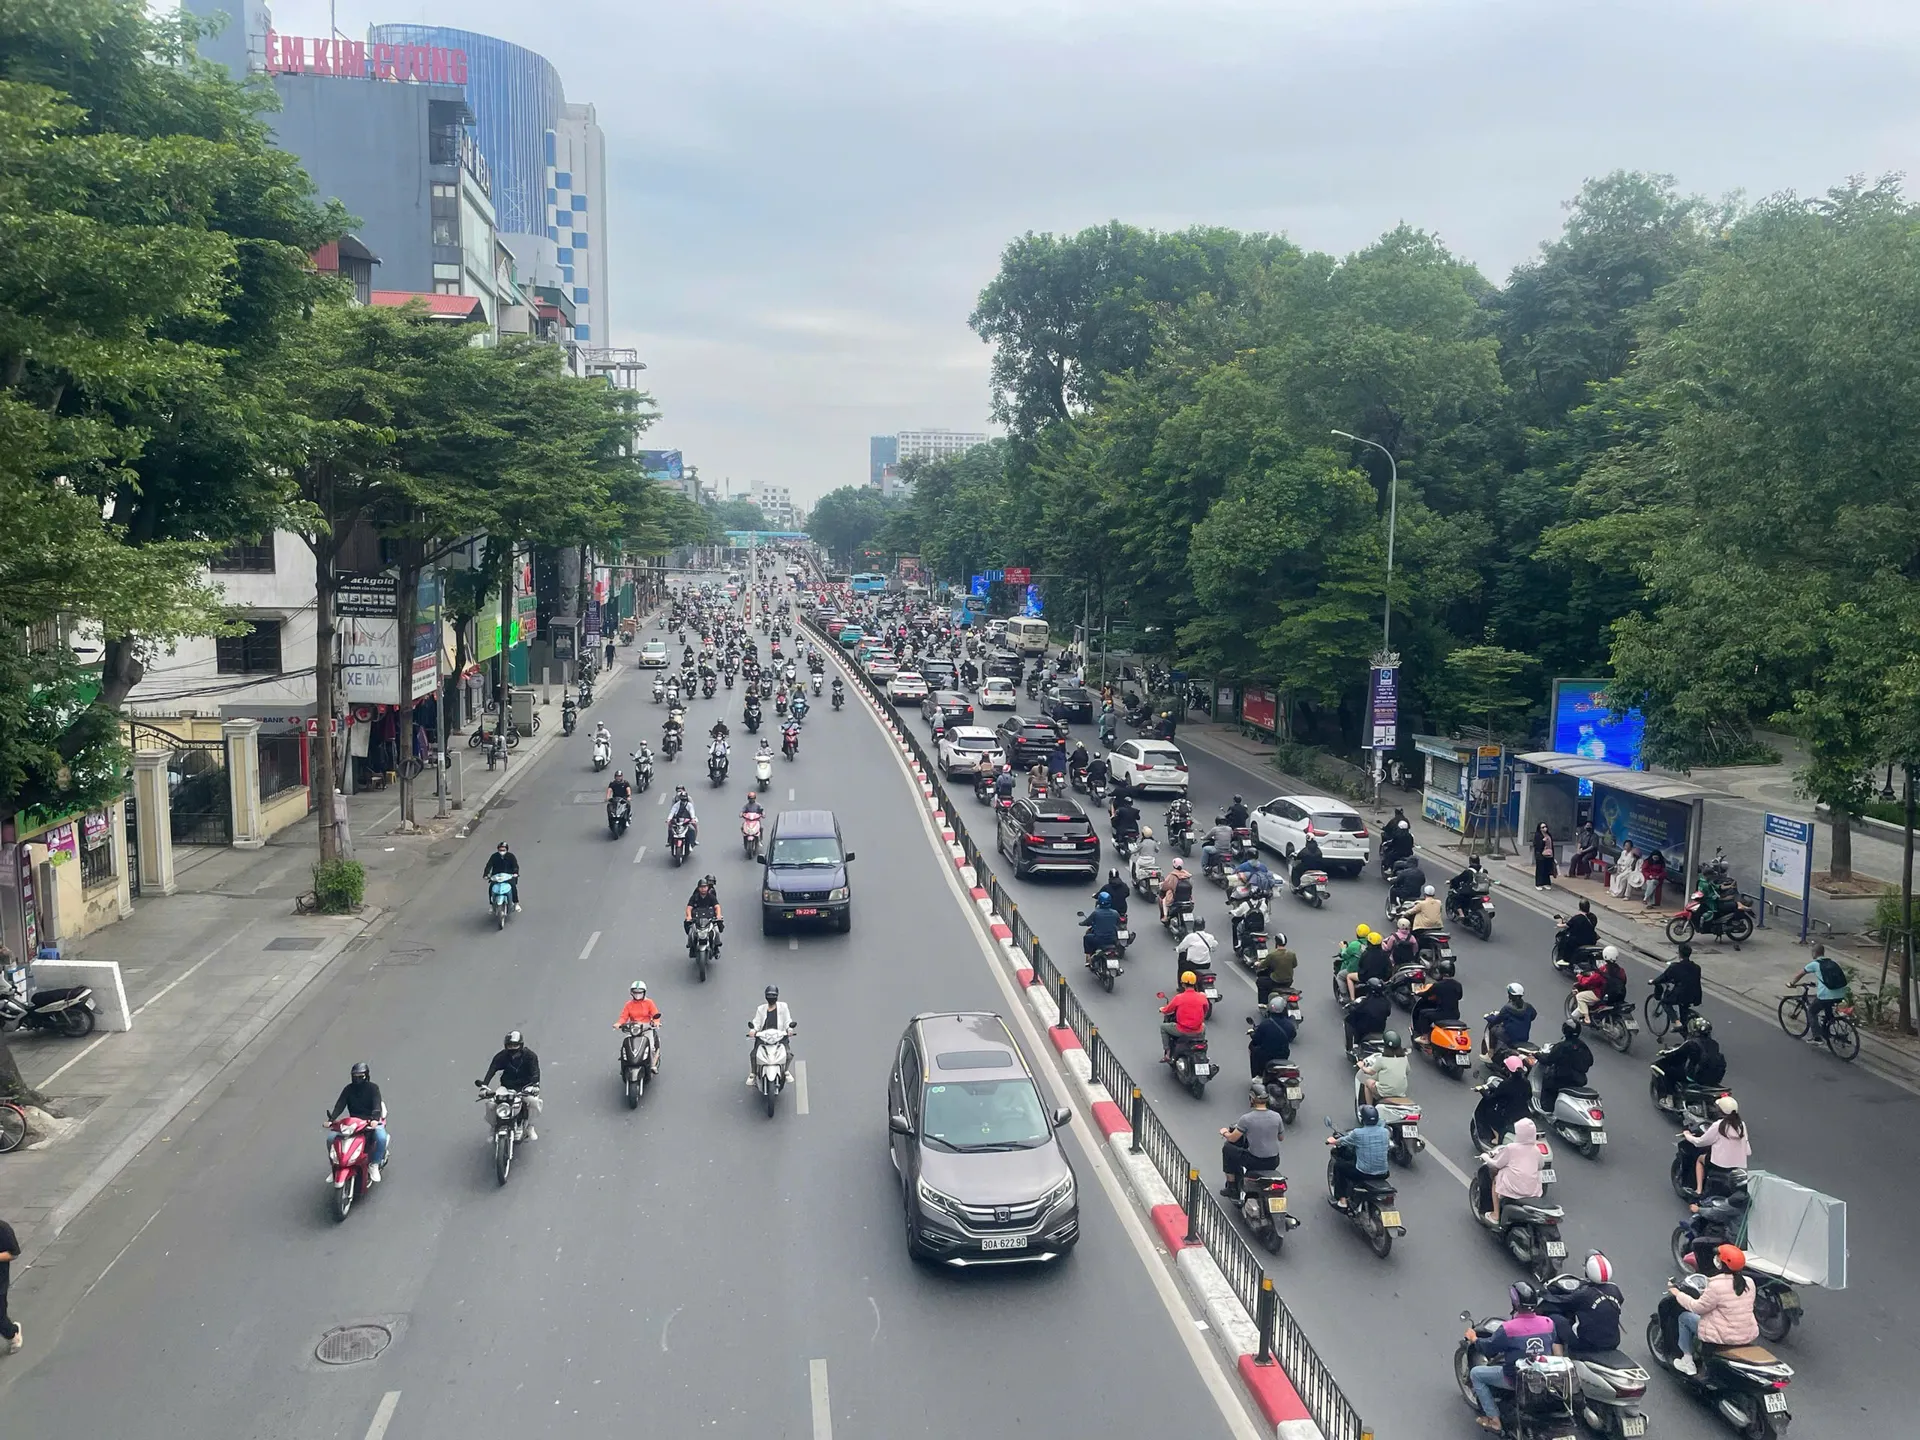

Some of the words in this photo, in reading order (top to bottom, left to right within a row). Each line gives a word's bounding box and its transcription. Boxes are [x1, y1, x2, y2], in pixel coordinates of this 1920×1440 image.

[313, 37, 365, 77] KIM
[373, 41, 468, 85] CƯƠNG
[346, 672, 362, 686] XE
